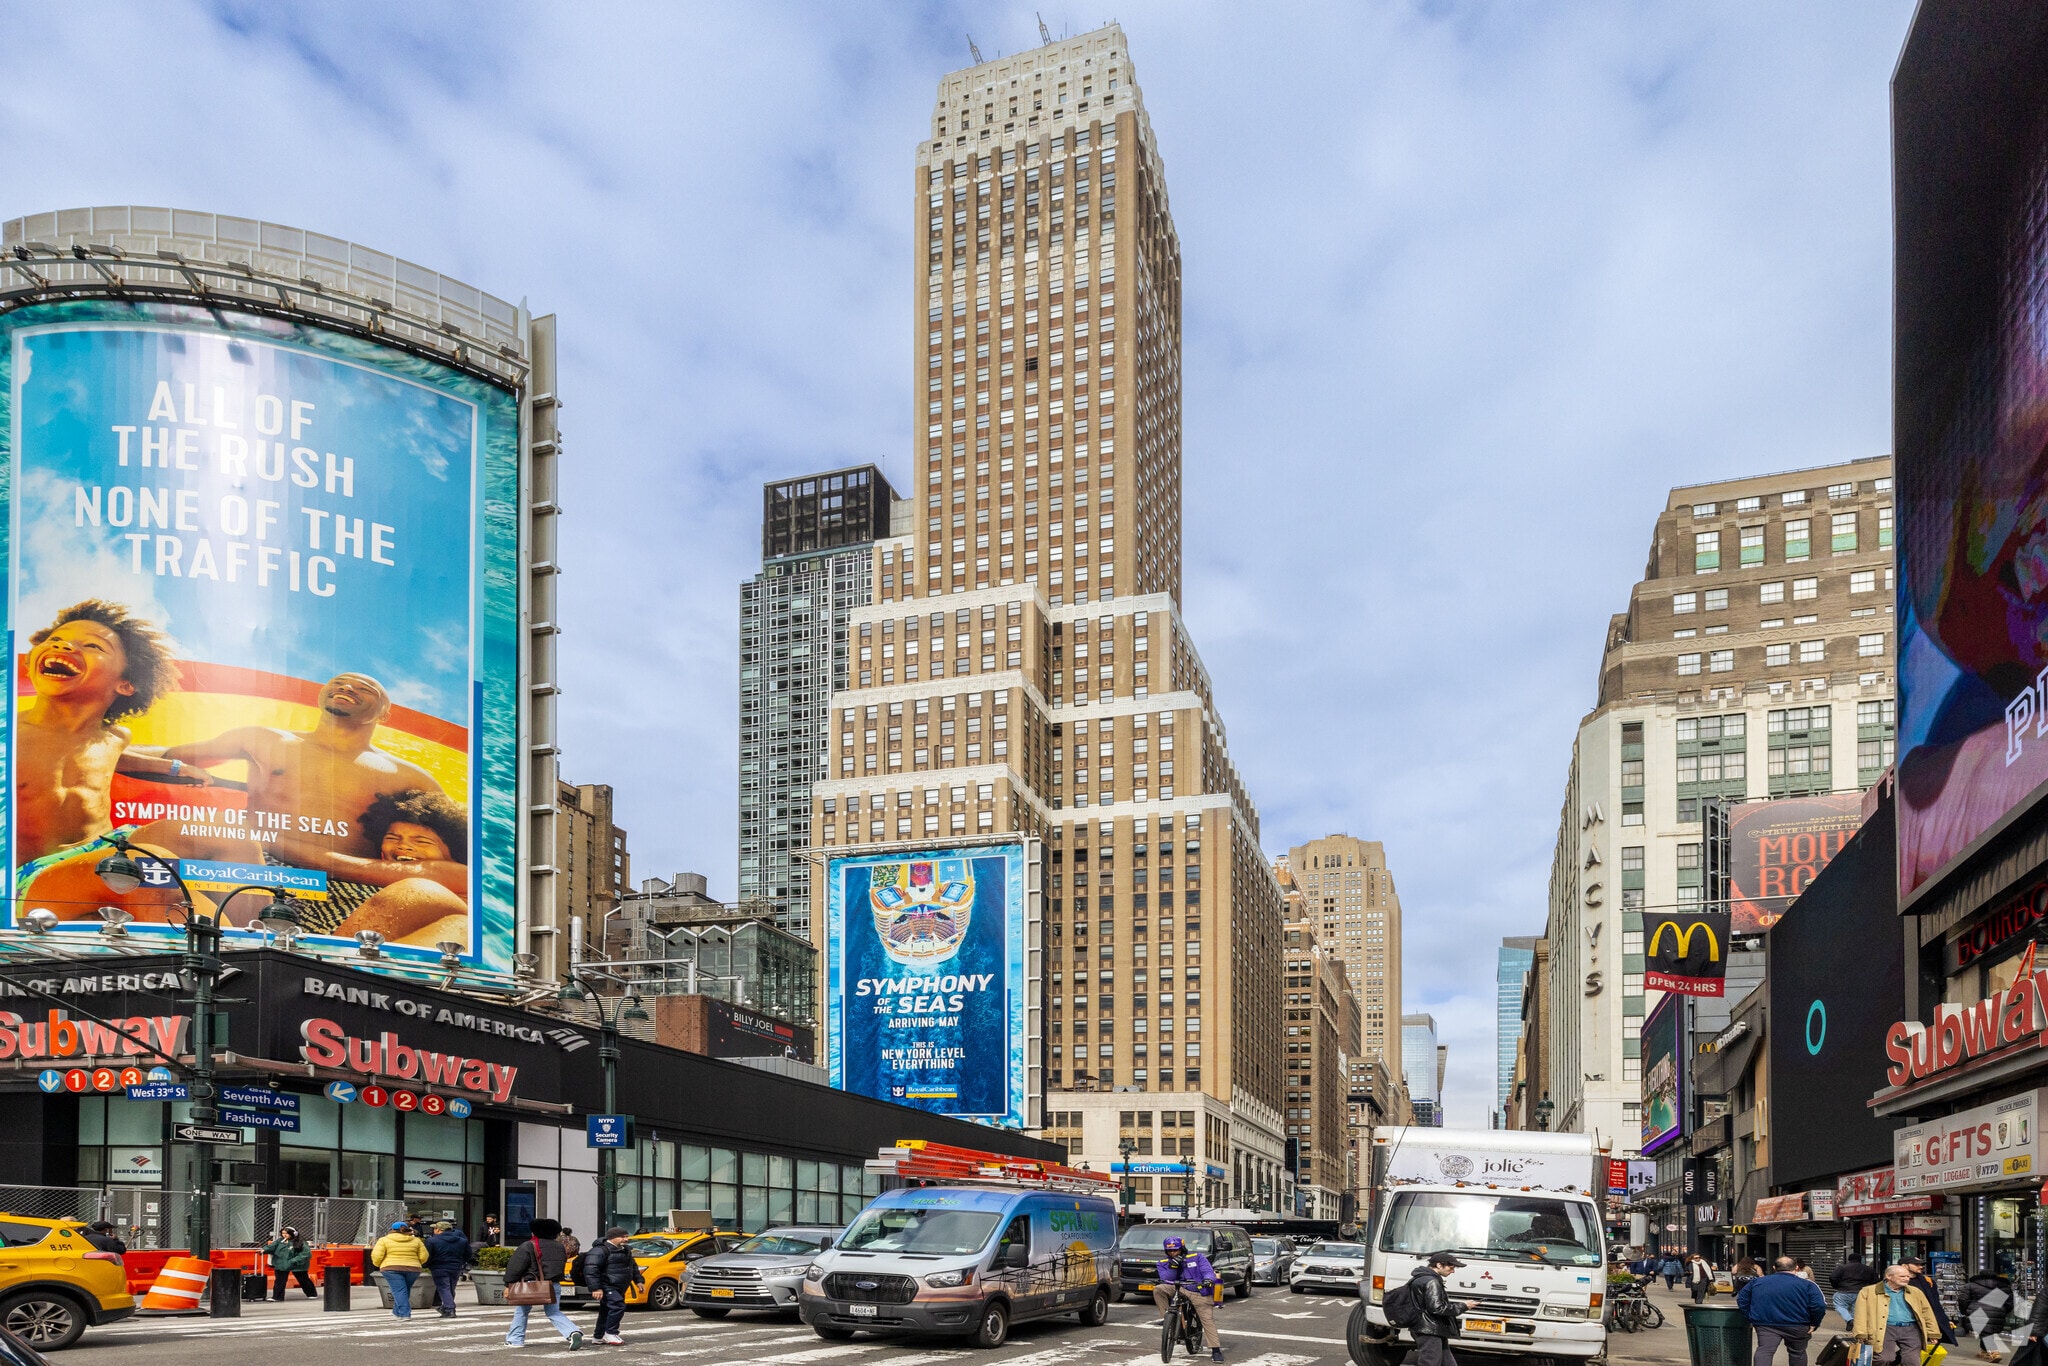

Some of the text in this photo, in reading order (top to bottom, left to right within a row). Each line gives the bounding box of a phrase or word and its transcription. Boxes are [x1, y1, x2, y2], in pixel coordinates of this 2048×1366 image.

[148, 380, 315, 440] ALL OF
[111, 425, 354, 498] THE RUSH
[75, 486, 396, 567] NONE OF THE
[124, 533, 337, 598] TRAFFIC
[115, 801, 349, 838] SYMPHONY OF THE SEAS
[1807, 824, 1841, 833] BEAUTY
[180, 824, 278, 844] ARRIVING MAY
[1760, 829, 1858, 866] MOU
[185, 864, 320, 887] RoyalCaribbean
[186, 883, 320, 899] INTERATNAL
[27, 979, 57, 996] OF
[62, 972, 181, 994] AMERICA
[856, 974, 994, 996] SYMPHONY
[1649, 977, 1717, 992] OPEN 24 HRS
[304, 977, 545, 1045] BANK OF AMERICA
[873, 1006, 892, 1014] THE
[897, 995, 964, 1013] SEAS
[734, 1012, 753, 1026] BILLY
[755, 1019, 774, 1032] JOEL
[888, 1017, 958, 1028] ARRIVING MAY
[301, 1018, 517, 1102] Subway
[882, 1047, 966, 1060] NEW YORK LEVEL
[892, 1059, 955, 1070] EVERYTHING
[71, 1072, 80, 1087] 1
[98, 1072, 109, 1087] 2
[125, 1071, 137, 1085] 3
[132, 1087, 186, 1098] West 33rd St
[224, 1090, 295, 1108] Seventh Ave
[370, 1090, 468, 1115] 1 2 3 MTA
[225, 1112, 294, 1128] Fashion Ave
[185, 1129, 203, 1137] ONE
[1926, 1122, 1992, 1166] GIFTS
[1133, 1164, 1171, 1173] citibank
[1482, 1158, 1524, 1174] jolie
[1981, 1163, 1999, 1176] NYPD
[1944, 1169, 1970, 1182] LUGGAGE
[1854, 1170, 1895, 1201] PIZZ
[1050, 1208, 1099, 1232] SPRING
[1061, 1233, 1093, 1241] SCAFFOLDING
[1460, 1281, 1540, 1294] USO
